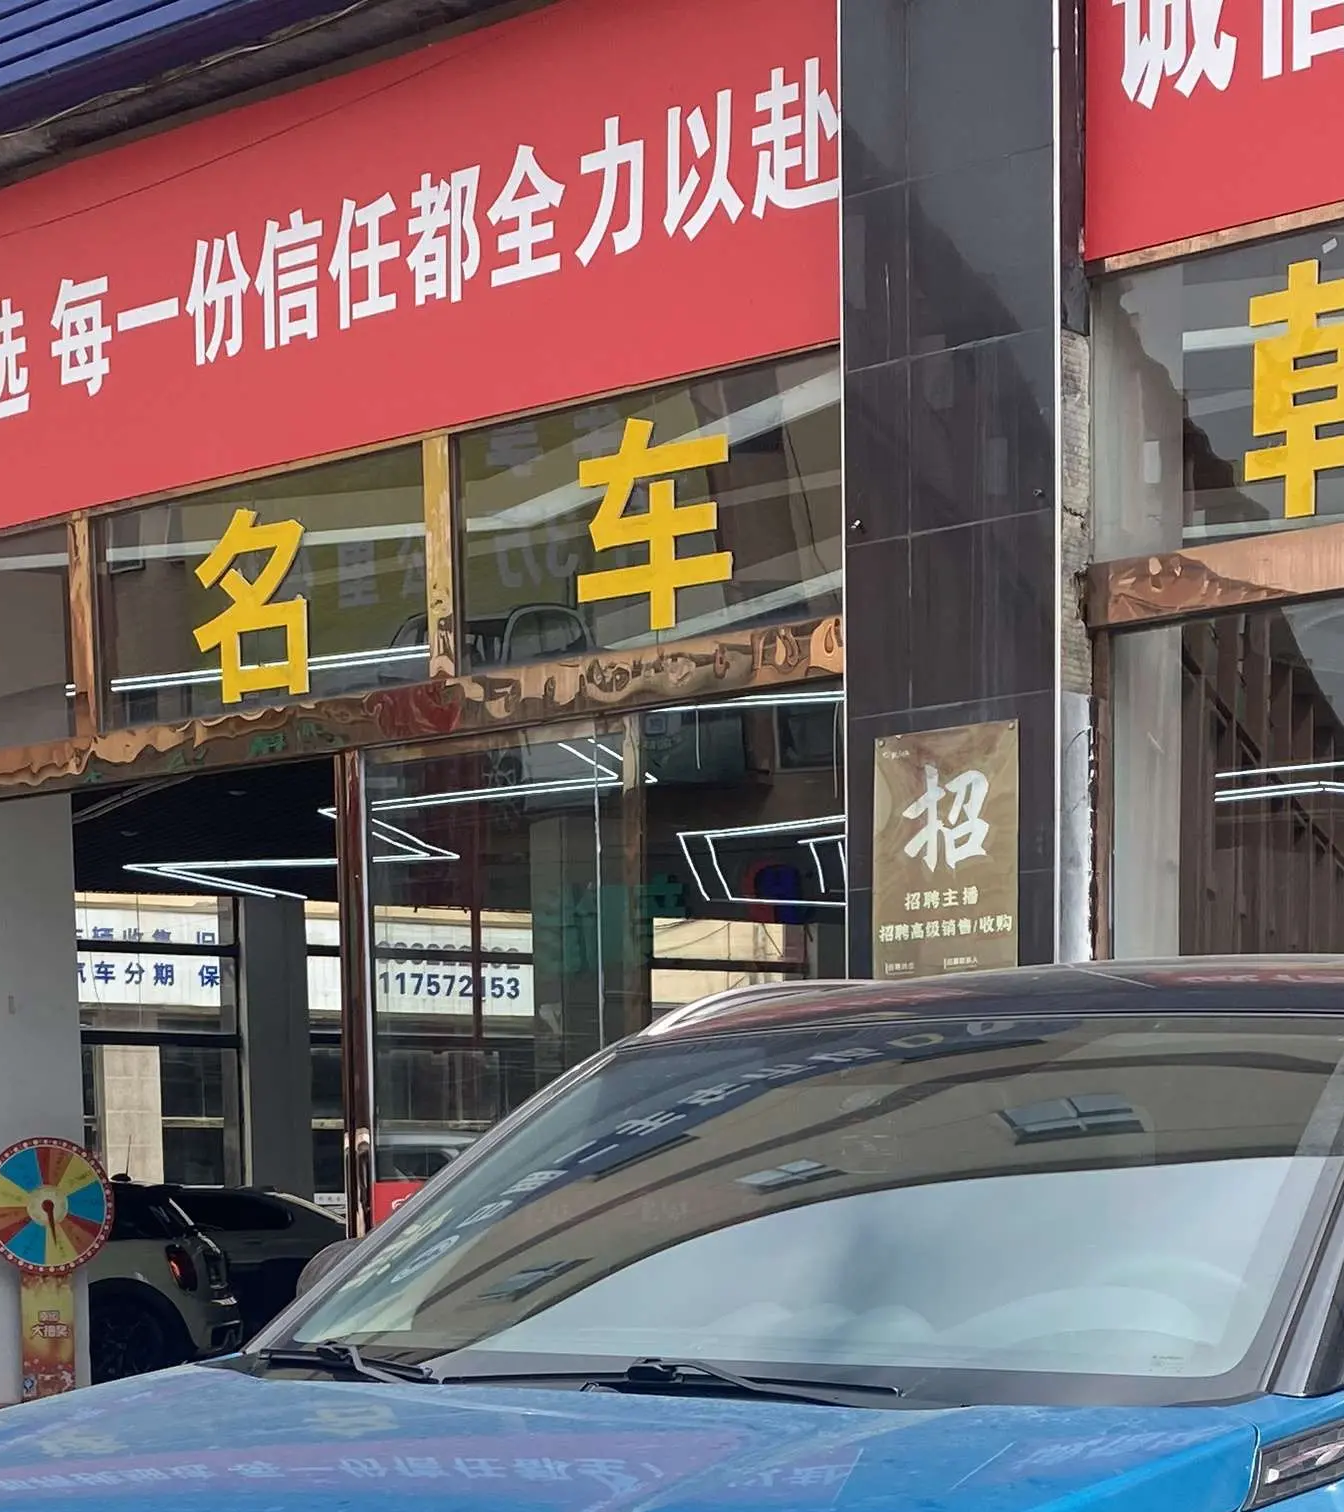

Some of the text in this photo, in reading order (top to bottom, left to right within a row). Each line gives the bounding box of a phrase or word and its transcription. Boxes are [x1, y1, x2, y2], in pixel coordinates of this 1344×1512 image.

[50, 57, 839, 397] 每一份信任都全力以赴
[903, 763, 990, 872] 招
[879, 914, 1013, 943] 招聘高级销售/收购
[904, 886, 979, 911] 招聘主播
